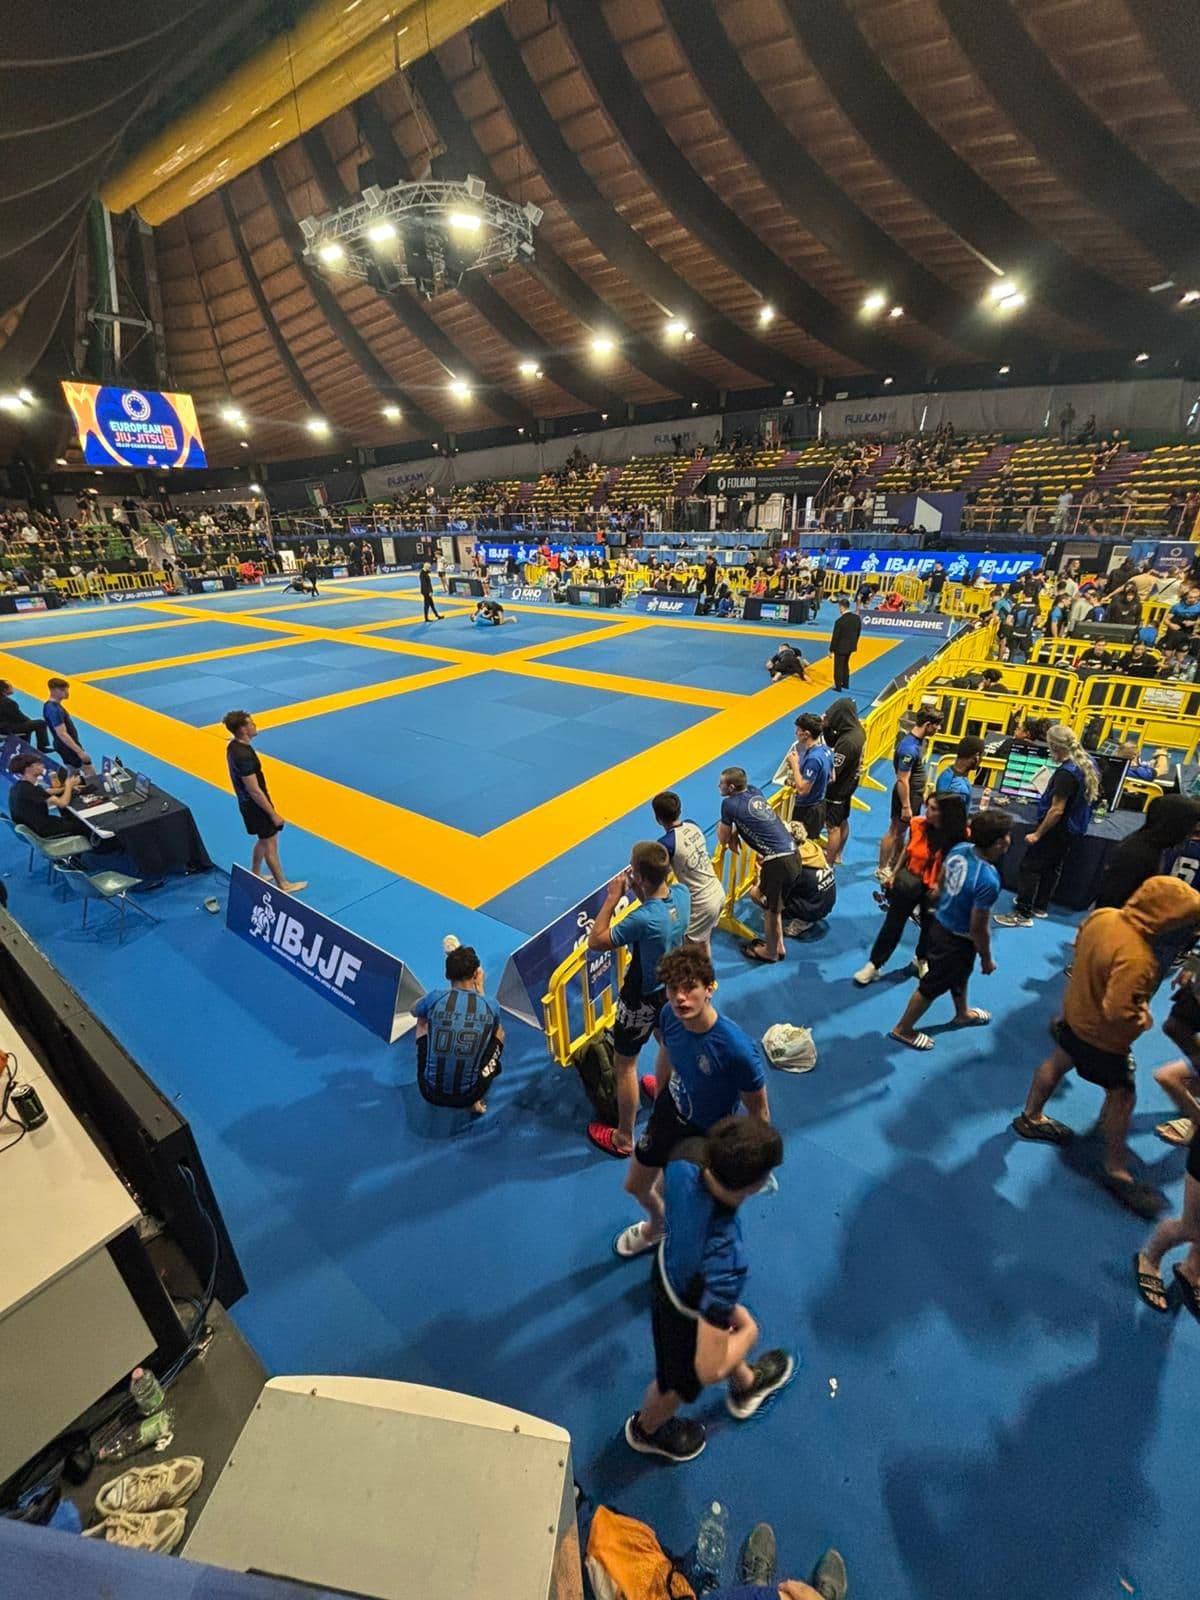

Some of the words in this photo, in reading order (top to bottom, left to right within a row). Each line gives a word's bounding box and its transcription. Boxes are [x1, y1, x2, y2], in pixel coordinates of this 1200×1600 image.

[109, 420, 162, 434] EUROPEAN
[115, 431, 164, 444] JIU-JITSU
[727, 477, 757, 489] FIJLKAM
[885, 557, 936, 573] IBJJF
[871, 616, 913, 628] GROUND
[913, 619, 944, 630] GAME
[273, 911, 362, 988] IBJJF
